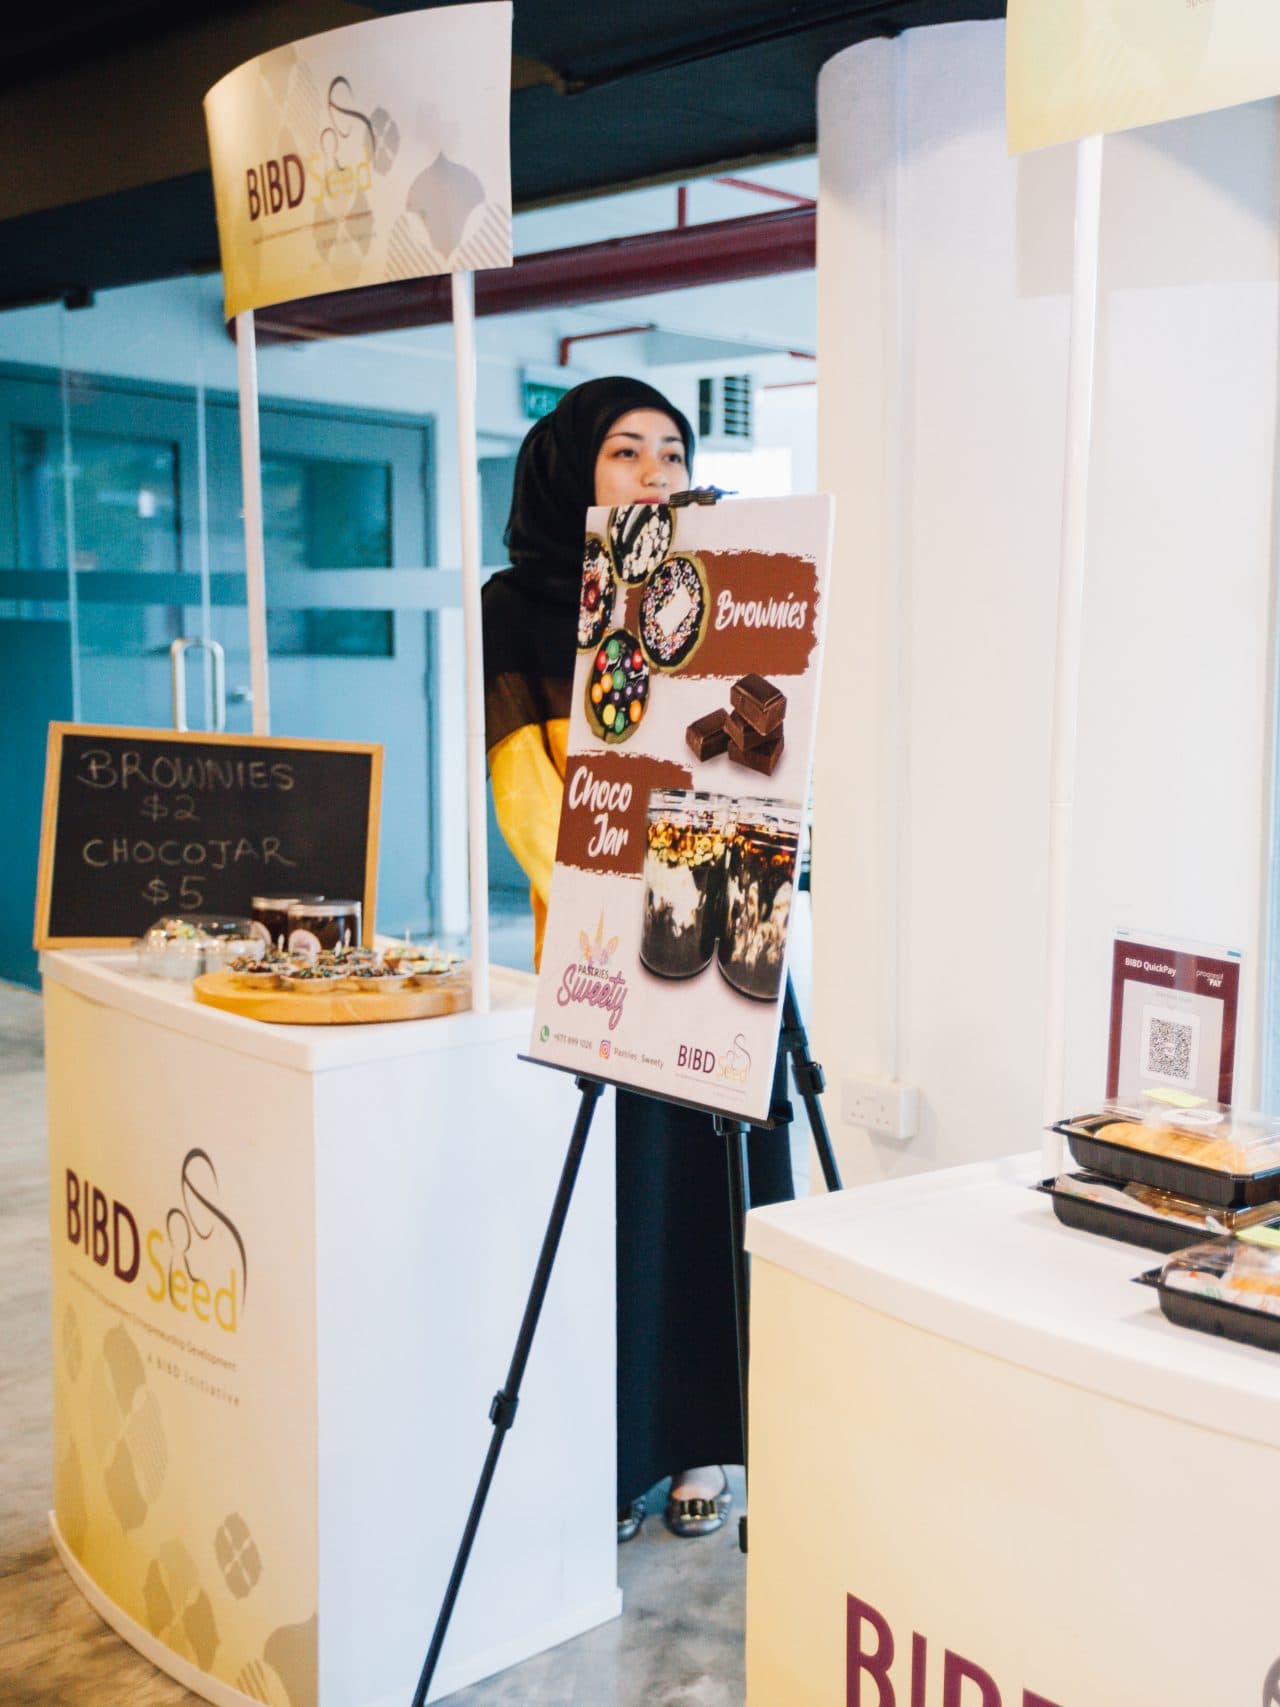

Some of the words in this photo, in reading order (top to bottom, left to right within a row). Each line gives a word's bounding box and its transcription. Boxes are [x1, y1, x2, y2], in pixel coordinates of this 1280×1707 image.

[246, 153, 305, 222] BIBD
[307, 144, 372, 204] Seed
[714, 588, 808, 631] Brownies
[77, 749, 296, 792] BROWNIES
[568, 764, 633, 812] Choco
[140, 793, 200, 823] $2
[587, 812, 629, 858] Jar
[141, 875, 207, 910] $5
[578, 964, 609, 980] PASTRIES
[1125, 957, 1142, 969] BIBD
[1143, 960, 1177, 977] QuickPay
[556, 963, 628, 1031] Sweety
[677, 1044, 716, 1074] BIBD
[66, 1168, 141, 1284] BIBD
[145, 1228, 237, 1334] Seed
